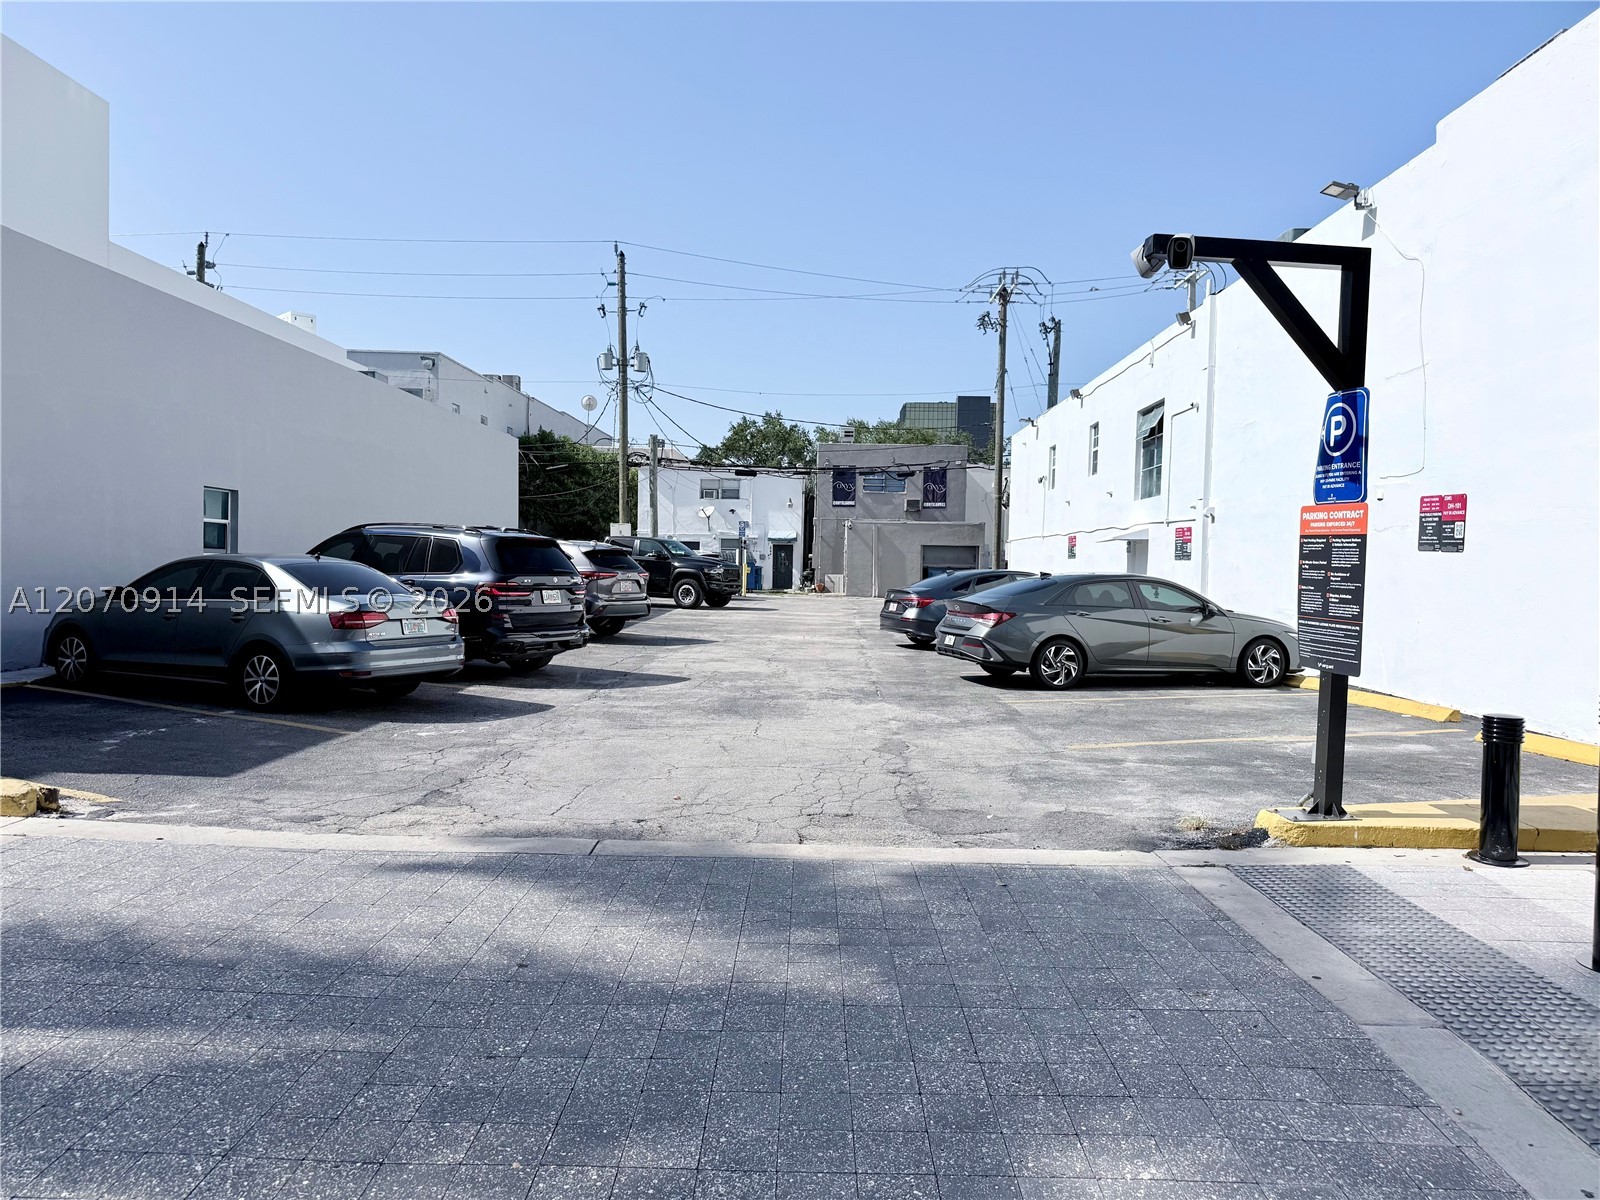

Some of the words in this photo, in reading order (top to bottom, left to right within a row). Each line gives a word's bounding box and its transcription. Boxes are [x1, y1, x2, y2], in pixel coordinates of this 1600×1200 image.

[1330, 414, 1347, 447] P
[1332, 462, 1360, 470] ENTRANCE
[1302, 512, 1328, 520] PARKING
[1329, 510, 1364, 519] CONTRACT
